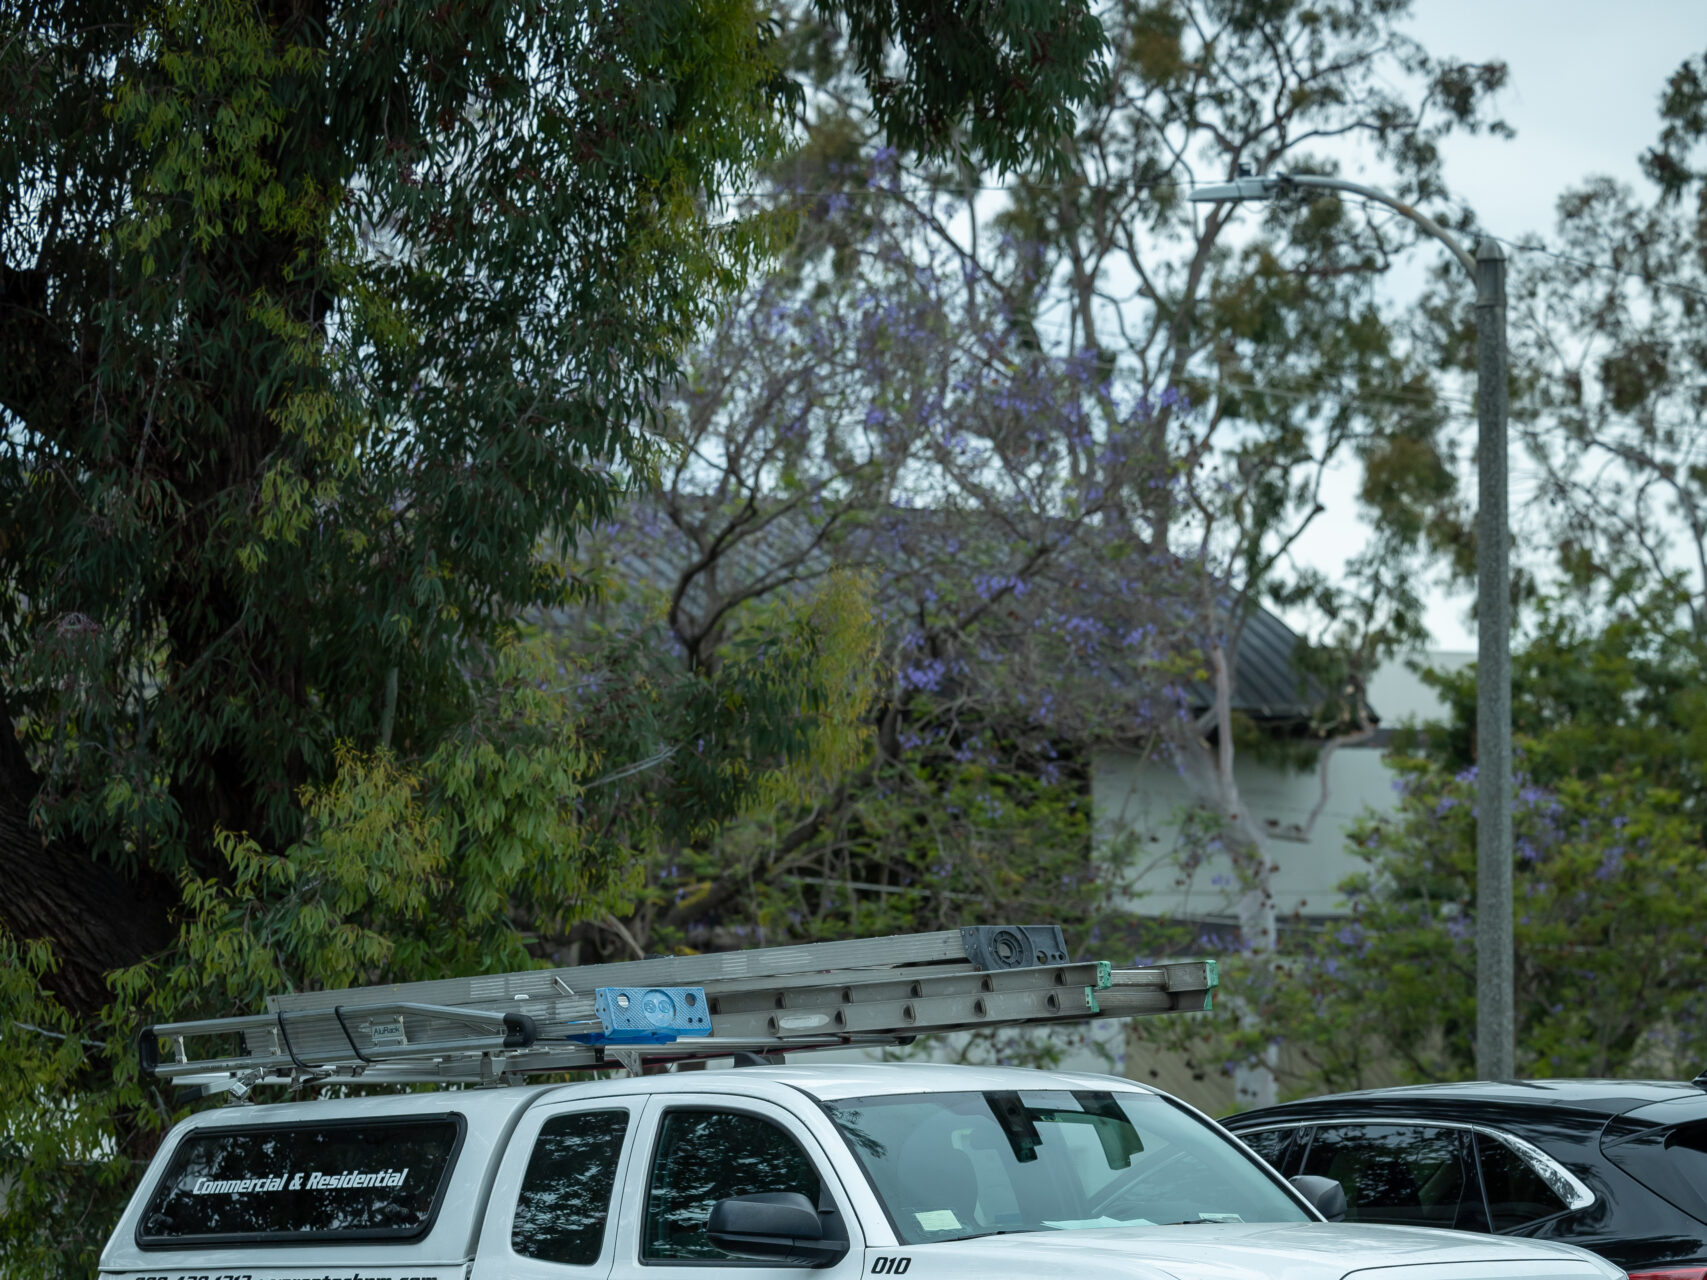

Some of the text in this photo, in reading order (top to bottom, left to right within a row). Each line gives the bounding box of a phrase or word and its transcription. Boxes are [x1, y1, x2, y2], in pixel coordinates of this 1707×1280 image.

[193, 1168, 409, 1195] Commercial & Residential
[871, 1256, 912, 1275] 010
